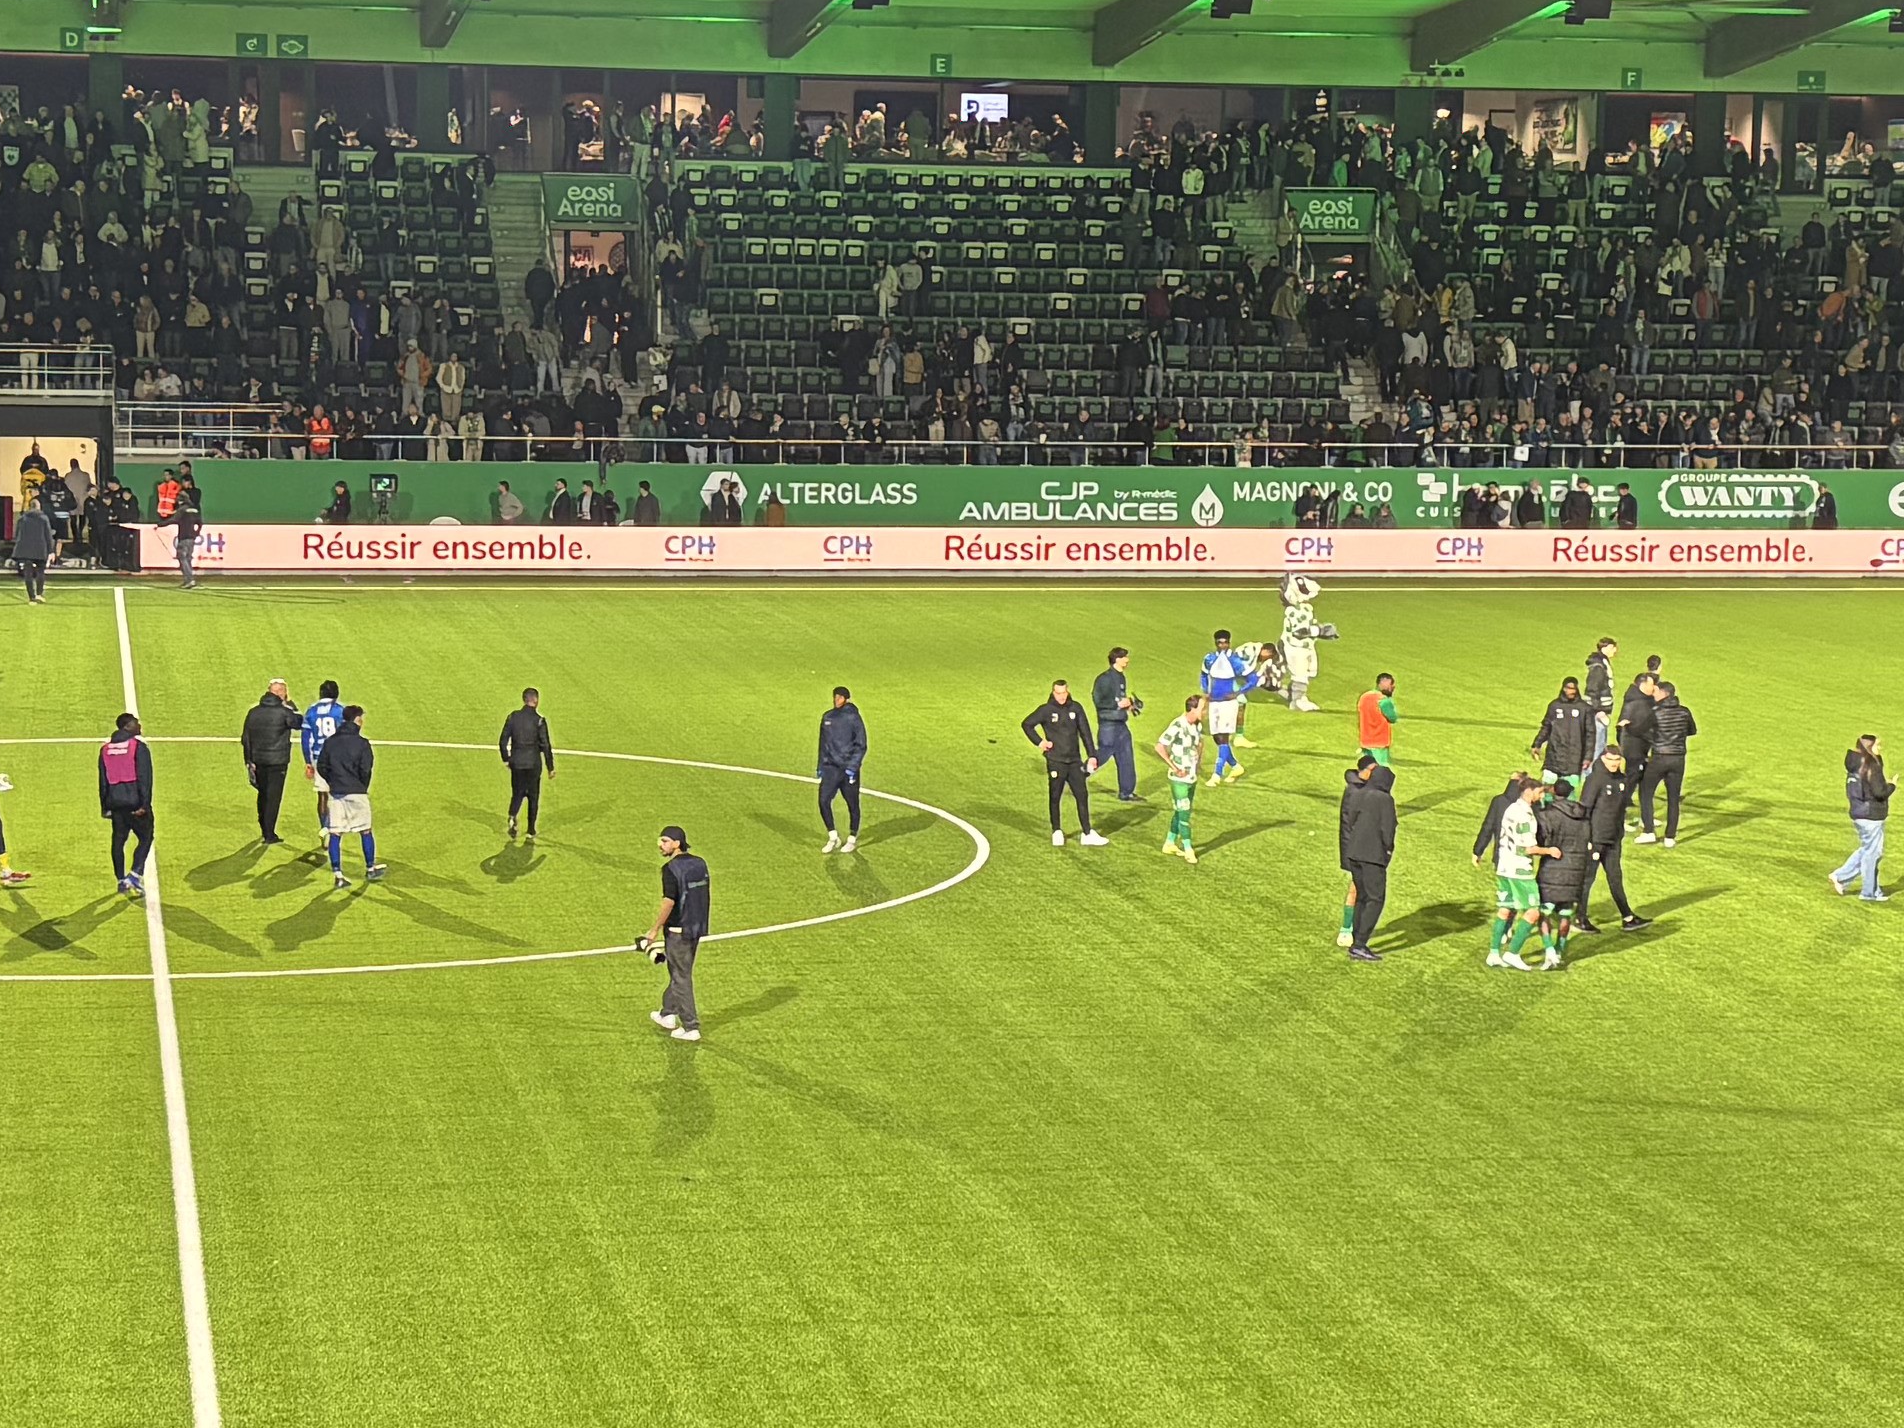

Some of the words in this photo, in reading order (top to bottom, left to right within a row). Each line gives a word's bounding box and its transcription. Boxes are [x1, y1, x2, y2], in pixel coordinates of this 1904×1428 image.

[65, 33, 78, 47] D
[936, 58, 946, 72] E
[1627, 72, 1636, 86] F
[567, 182, 615, 201] easi
[557, 198, 622, 217] Arena
[1309, 196, 1353, 214] easi
[1299, 211, 1359, 229] Arena
[1680, 474, 1729, 483] GROUPE
[758, 482, 918, 505] ALTERGLASS
[1040, 481, 1099, 501] CJP
[1343, 481, 1359, 502] &
[1364, 481, 1393, 502] CO
[1678, 485, 1803, 508] WANTY
[959, 502, 1178, 521] AMBULANCES
[302, 531, 423, 561] Réussir
[433, 533, 593, 561] ensemble.
[664, 534, 716, 556] CPH
[823, 535, 873, 554] CPH
[944, 534, 1056, 561] Réussir
[1066, 536, 1215, 562] ensemble.
[1285, 537, 1334, 556] CPH
[1436, 537, 1484, 558] CPH
[1553, 535, 1660, 563] Réussir
[1669, 537, 1814, 563] ensemble.
